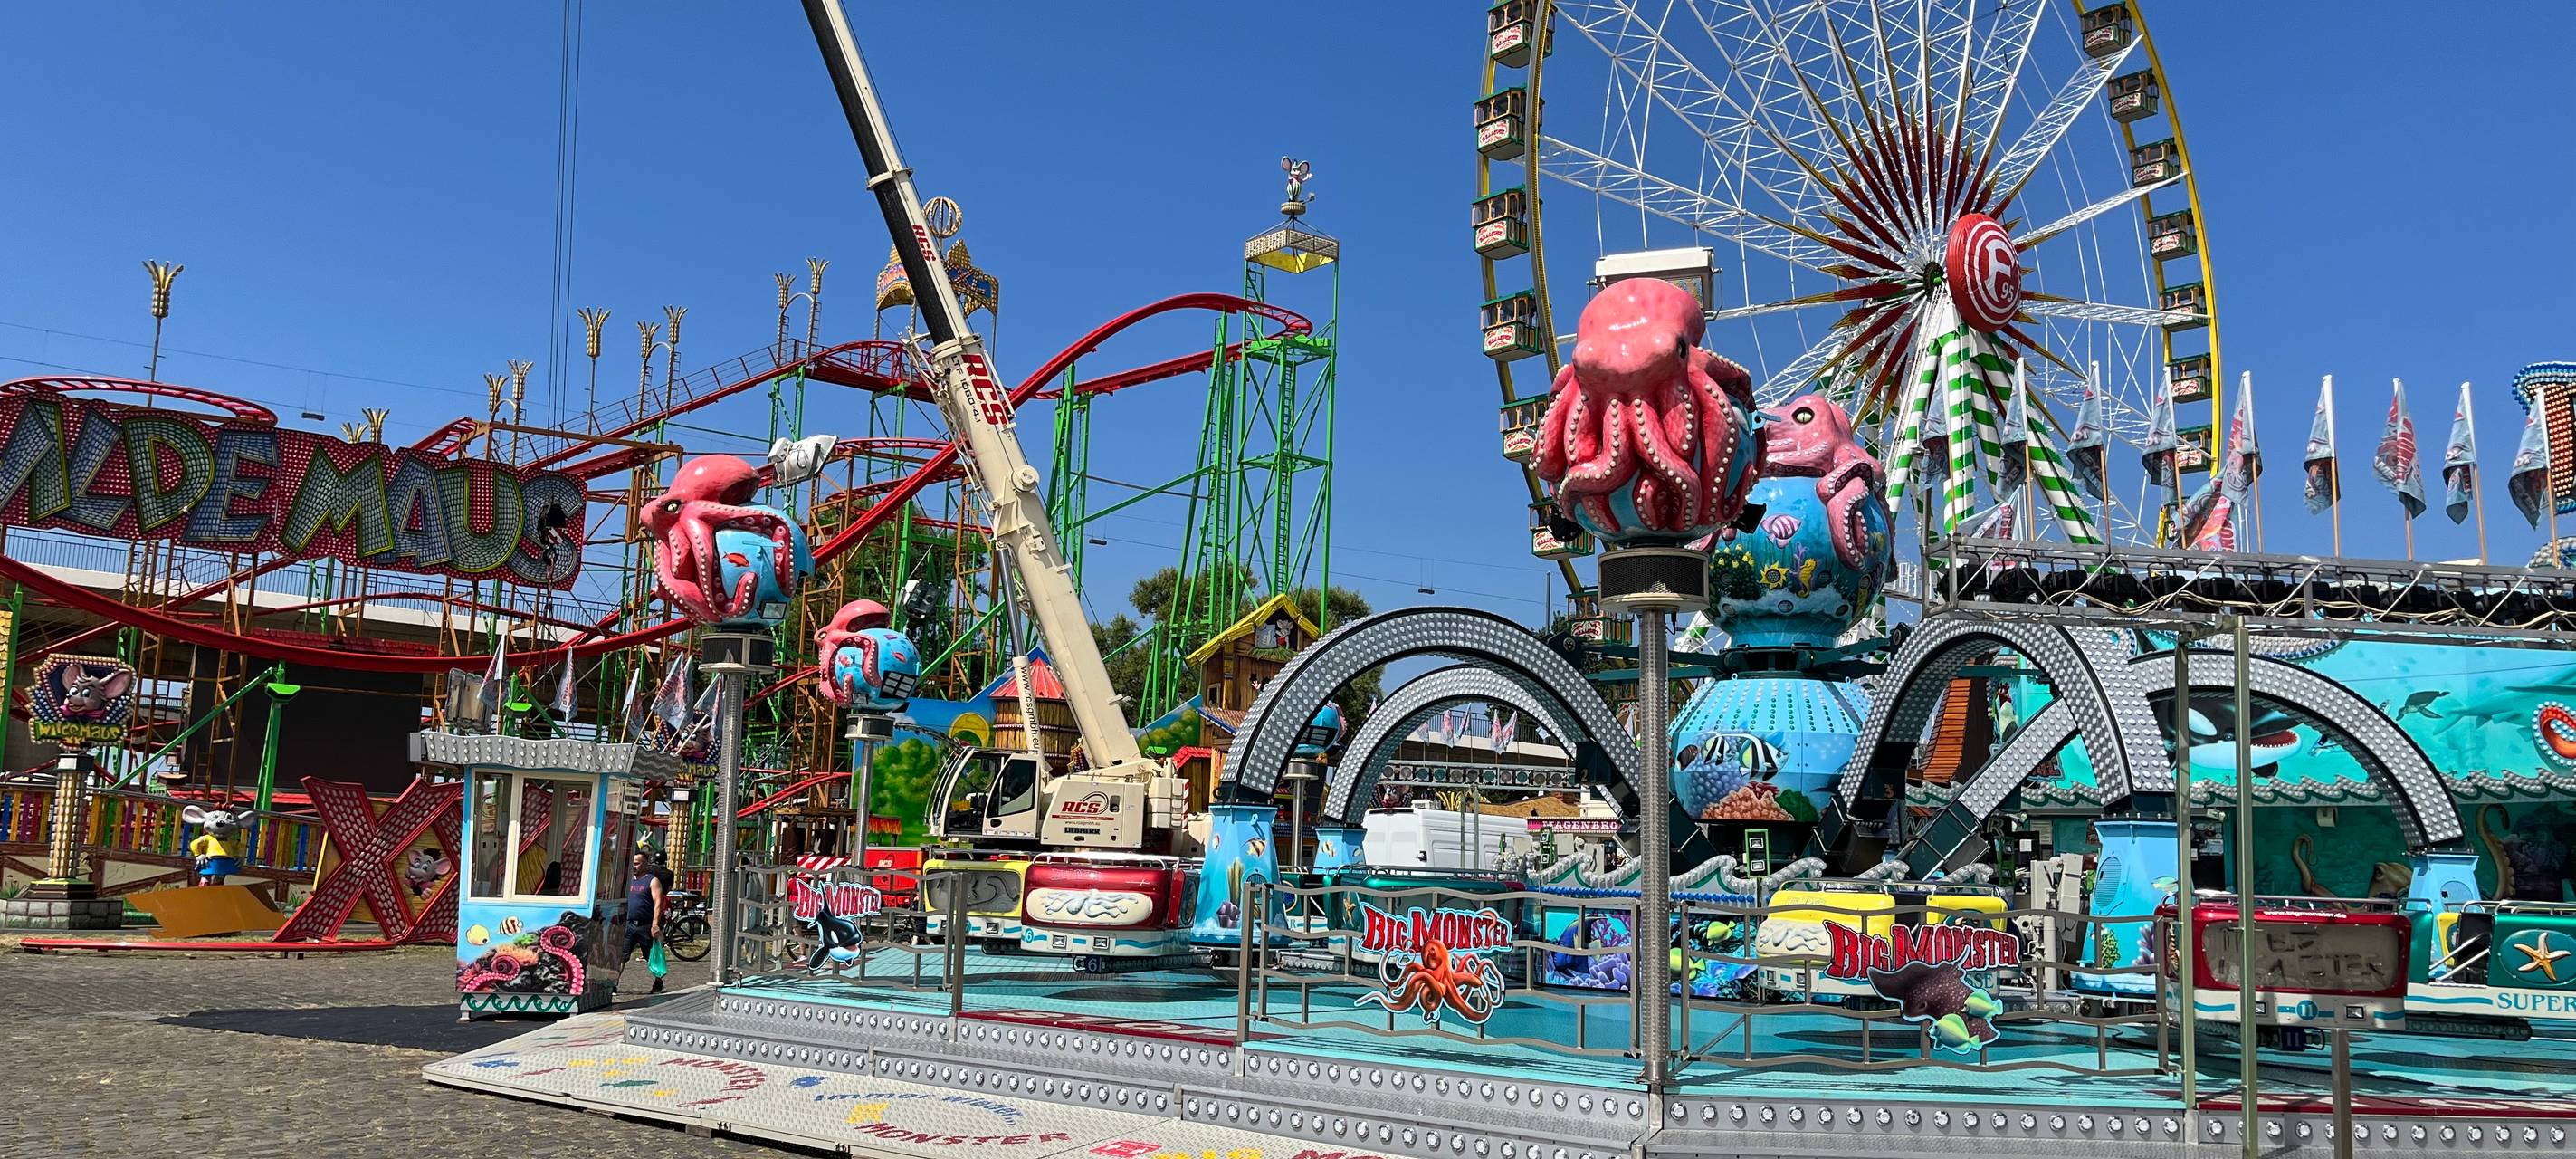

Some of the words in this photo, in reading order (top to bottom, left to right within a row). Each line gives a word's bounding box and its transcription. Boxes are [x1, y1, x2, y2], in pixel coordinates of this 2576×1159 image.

[911, 225, 936, 262] RCS
[2001, 282, 2014, 302] 95
[951, 355, 964, 375] LTF
[960, 354, 1008, 426] RCS
[279, 444, 584, 583] MAUS
[1061, 801, 1101, 813] RCS
[1064, 827, 1101, 835] LIEBHERR
[877, 859, 892, 867] RCS
[797, 882, 823, 918] BIG
[825, 884, 880, 917] MONSTER
[1026, 931, 1033, 942] 6
[1361, 905, 1409, 951] BIG
[1410, 910, 1510, 953] MONSTER
[1824, 922, 1891, 979] BIG
[1892, 925, 2018, 969] MONSTER
[1088, 958, 1098, 972] 6
[2301, 1004, 2314, 1017] 11
[2497, 992, 2576, 1012] SUPER
